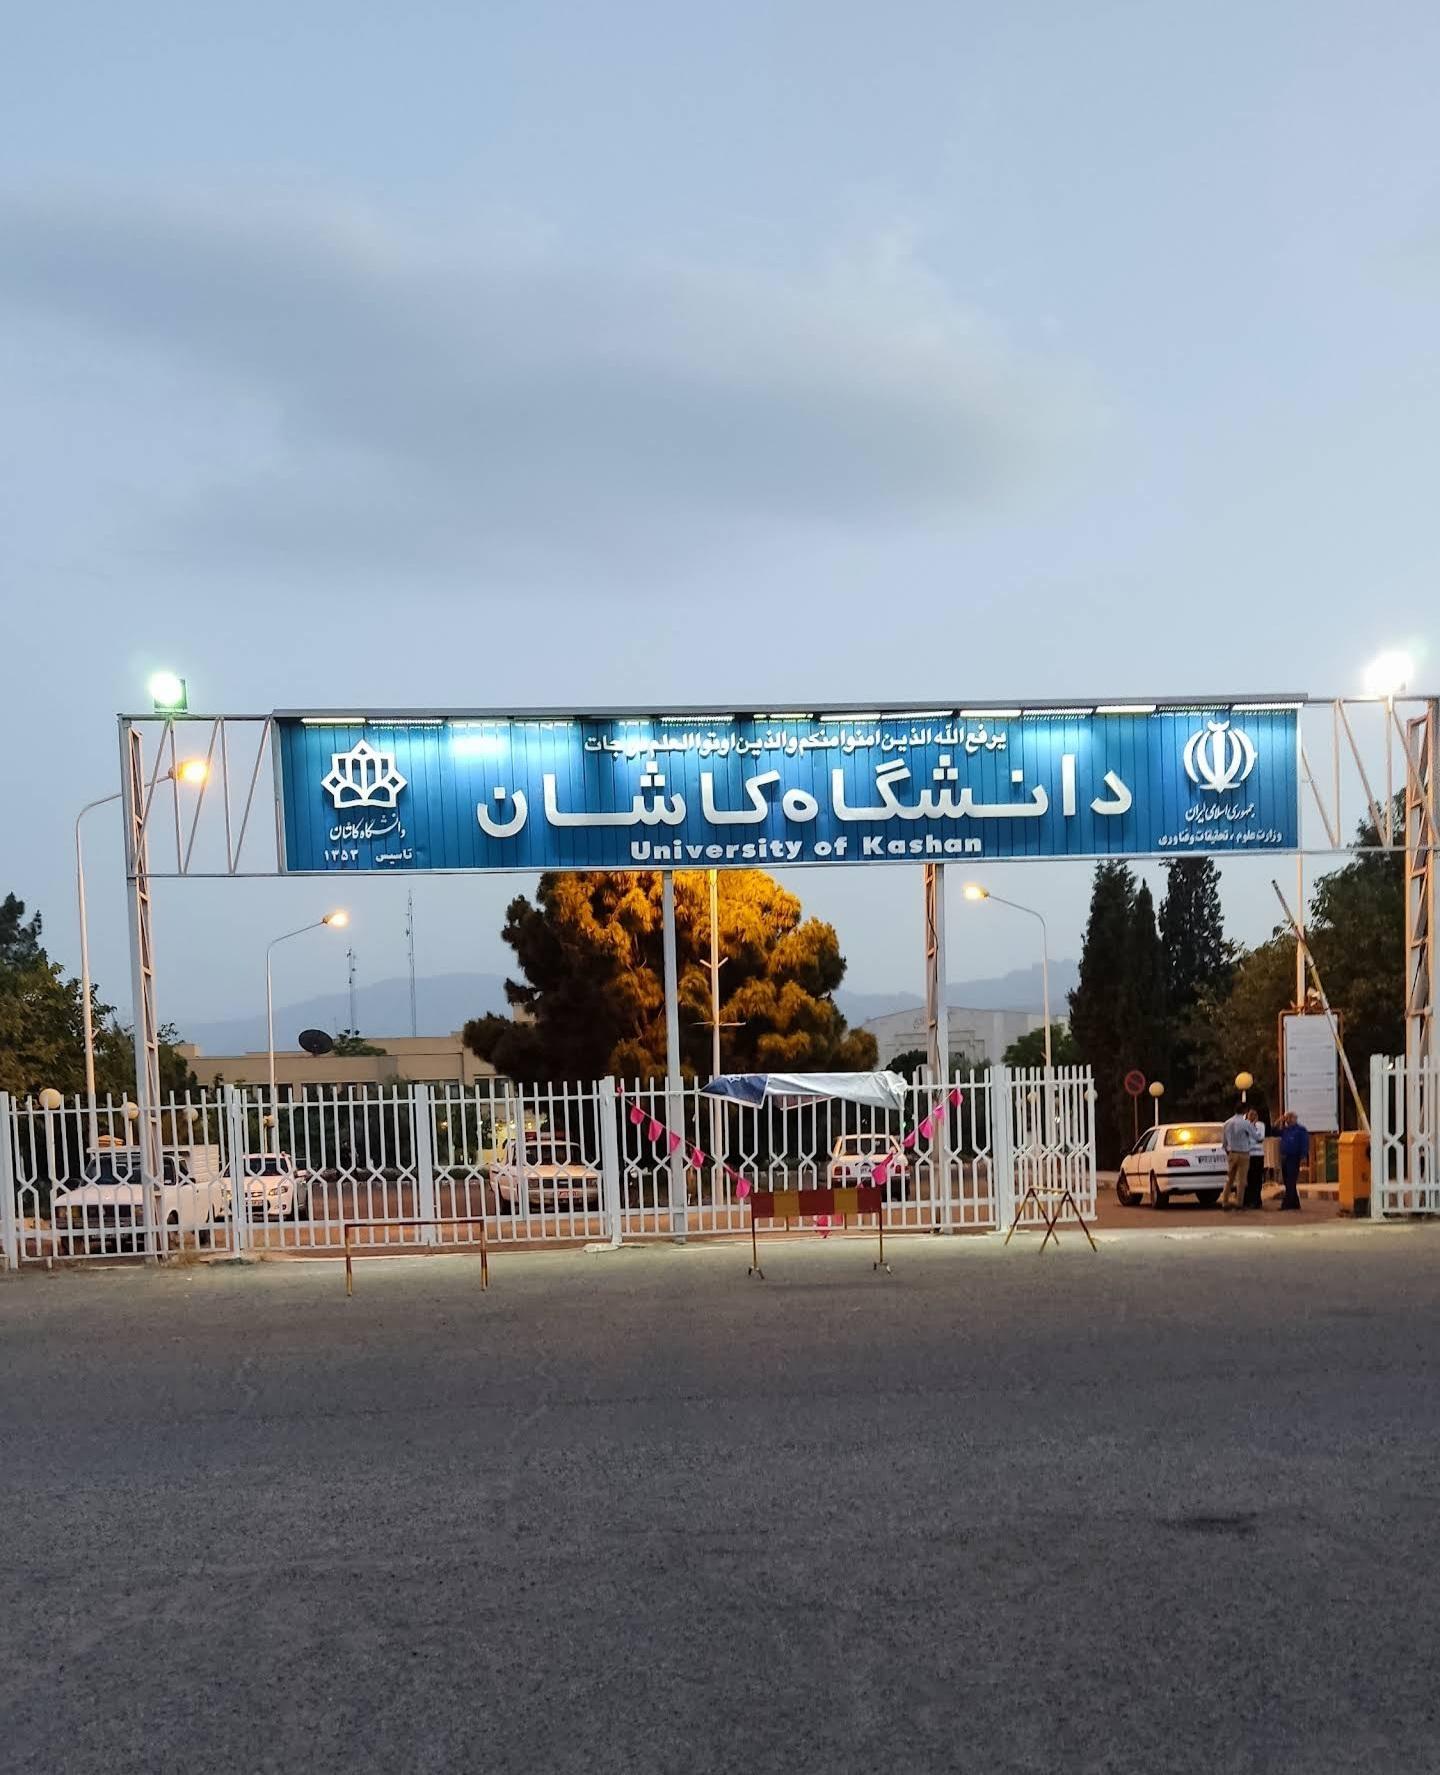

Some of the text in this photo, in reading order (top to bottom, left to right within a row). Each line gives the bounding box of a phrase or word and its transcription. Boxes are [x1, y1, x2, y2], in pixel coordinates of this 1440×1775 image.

[933, 721, 966, 745] الله
[476, 754, 1132, 838] دانشگاه کاشان
[1184, 802, 1255, 823] جمهوری اسلامی ایران
[329, 812, 406, 841] دانشگاه کاشان
[630, 833, 983, 860] University of Kashan
